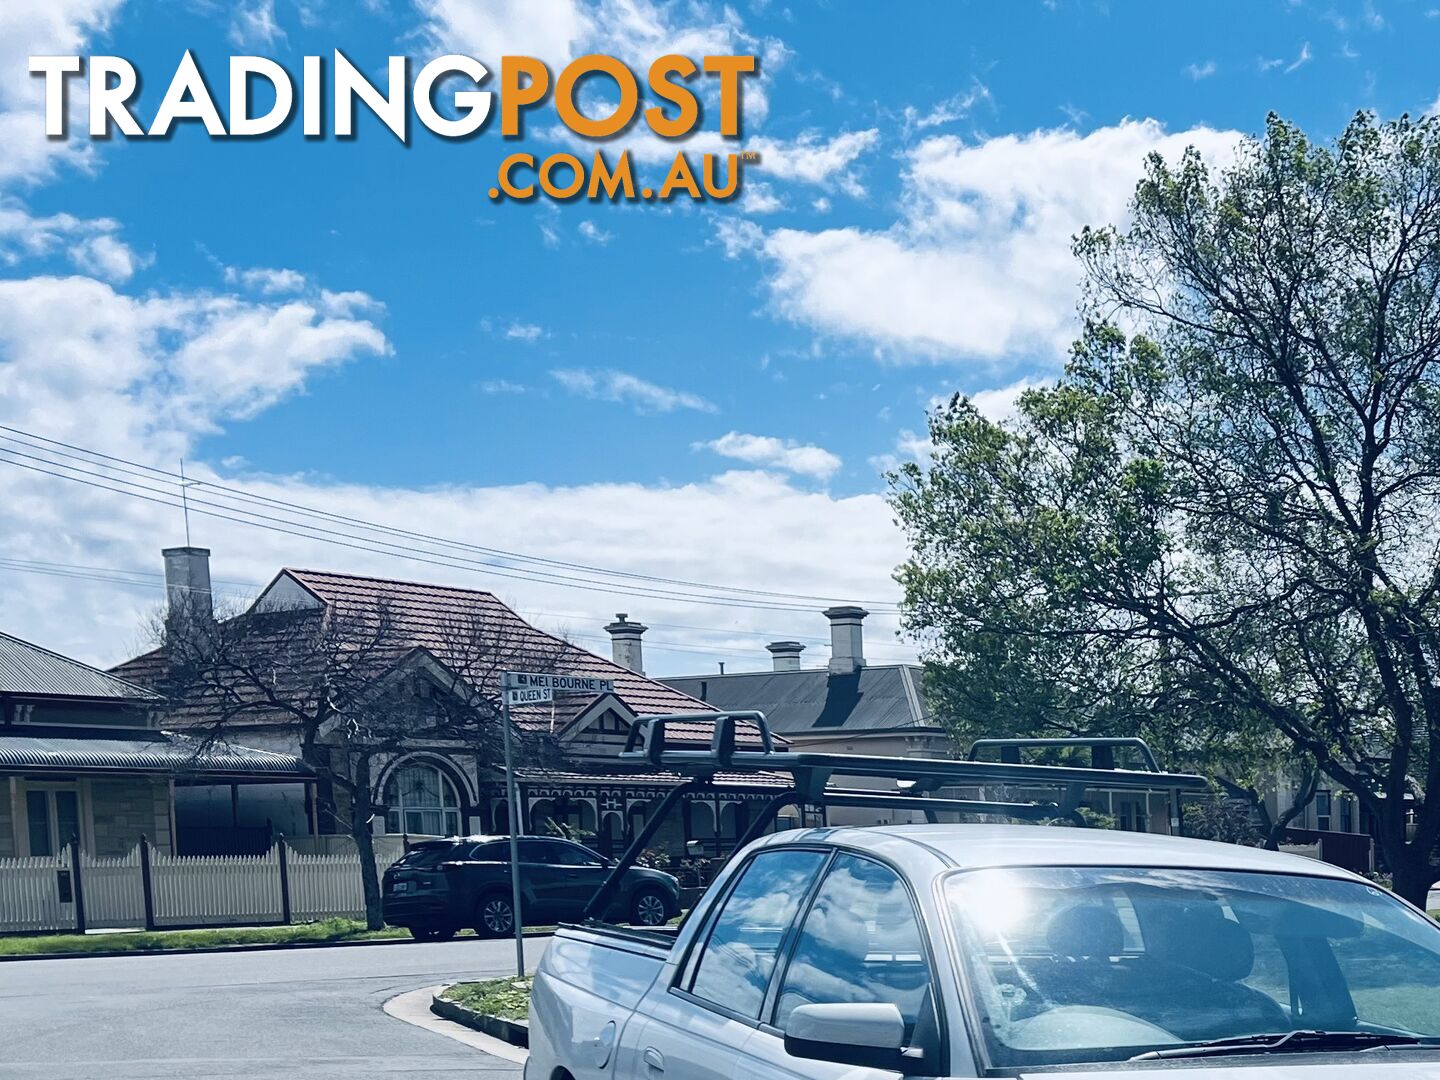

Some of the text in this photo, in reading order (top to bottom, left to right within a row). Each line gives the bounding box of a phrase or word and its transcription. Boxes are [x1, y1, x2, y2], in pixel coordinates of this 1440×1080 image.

[529, 676, 613, 690] MELBOURNE PL
[520, 688, 551, 702] QUEEN ST
